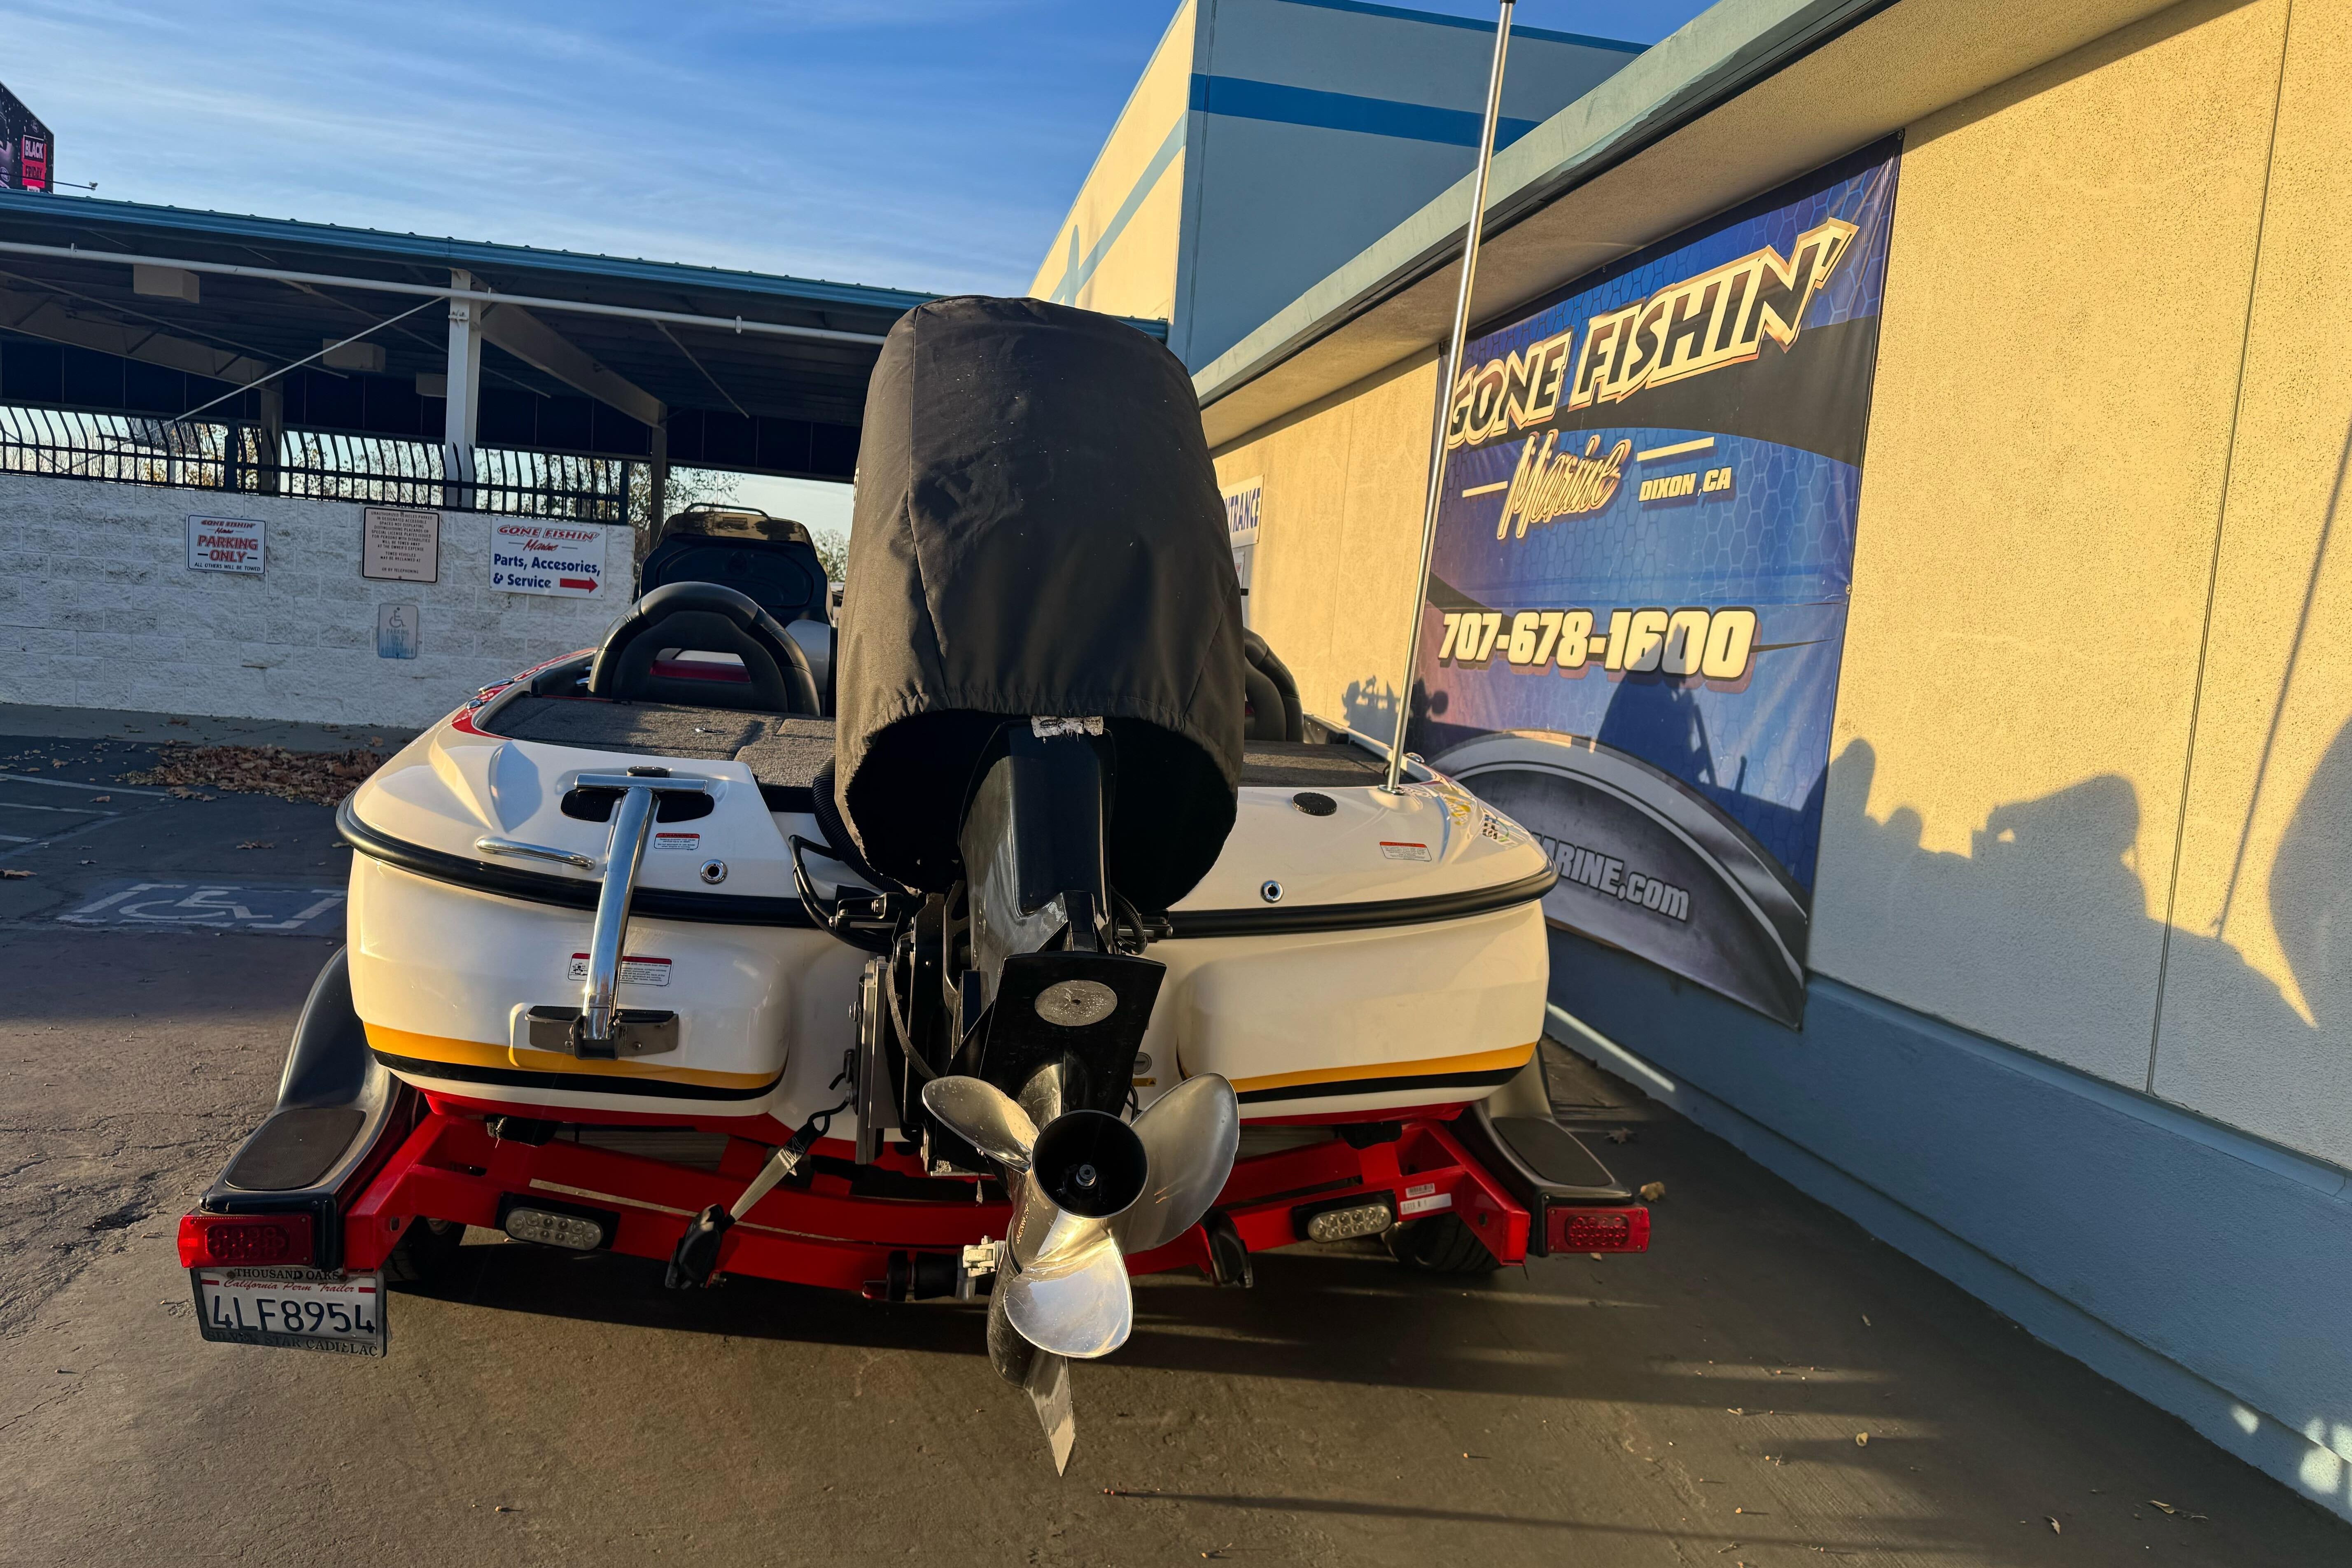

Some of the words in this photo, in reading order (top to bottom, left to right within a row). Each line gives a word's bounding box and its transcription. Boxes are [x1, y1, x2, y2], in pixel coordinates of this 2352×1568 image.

[25, 140, 43, 159] BLACK
[26, 166, 43, 180] FRIDAY
[1448, 329, 1573, 449] GONE
[1567, 217, 1860, 412] FISHIN'
[1497, 429, 1631, 540] Marine
[197, 534, 259, 551] PARKING
[497, 525, 542, 538] GONE
[543, 527, 600, 543] FISHIN'
[523, 539, 559, 551] Marine
[209, 549, 247, 563] ONLY
[494, 553, 527, 570] Parts,
[531, 557, 601, 576] Accesories,
[493, 572, 504, 584] &
[507, 574, 551, 588] Service
[1438, 607, 1757, 680] 707-678-1600
[234, 1268, 303, 1280] THOUSAND
[306, 1270, 339, 1281] OAKS
[224, 1279, 278, 1290] California
[282, 1282, 312, 1291] Perm
[318, 1283, 354, 1292] Trailer
[214, 1295, 375, 1334] 4LF8954
[264, 1334, 301, 1348] STAR
[306, 1339, 378, 1356] CADILLAC
